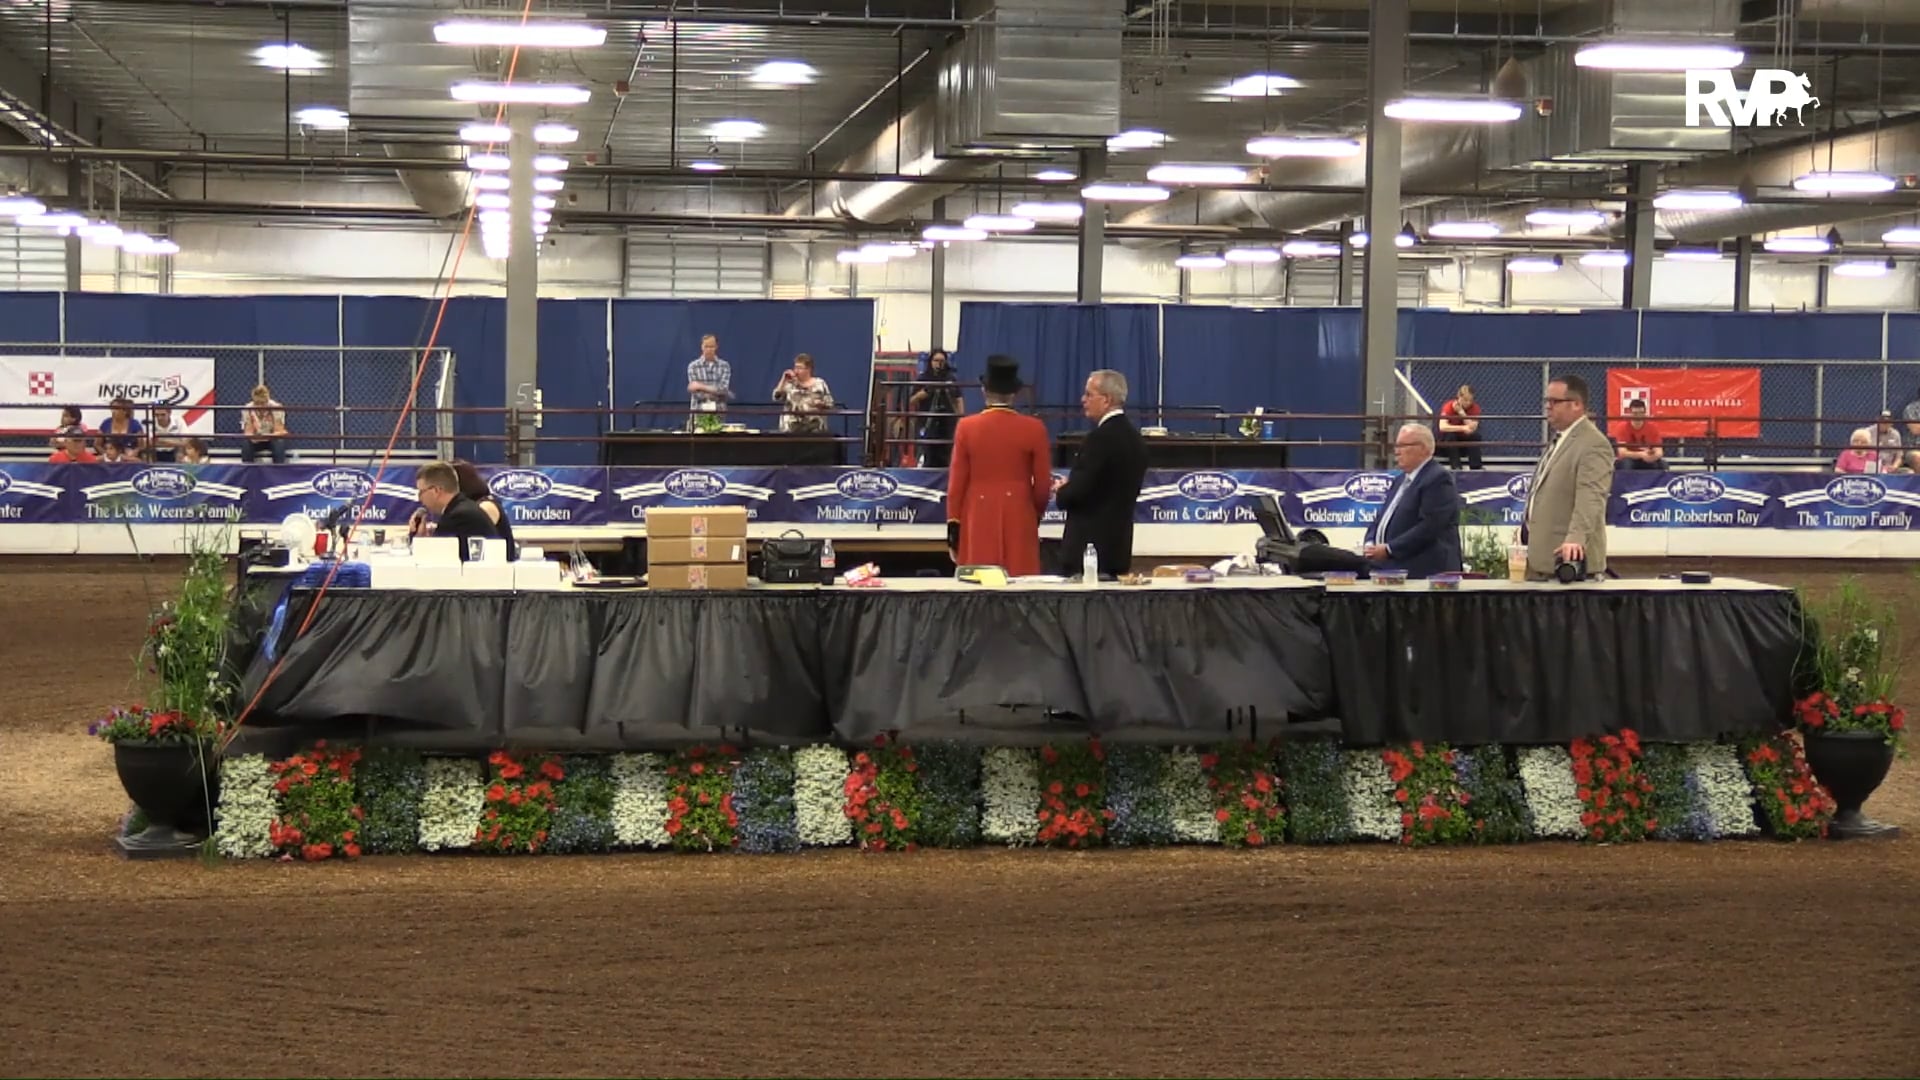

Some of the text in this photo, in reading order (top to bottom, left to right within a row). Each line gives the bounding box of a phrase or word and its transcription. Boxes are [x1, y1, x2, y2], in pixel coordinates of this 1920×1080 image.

[98, 384, 161, 399] INSIGHT
[84, 503, 110, 518] The
[511, 504, 571, 520] Thordsen
[816, 505, 917, 523] Mulberry Family
[1150, 505, 1178, 520] Tom
[1182, 506, 1190, 520] &
[1194, 506, 1231, 525] Cindy
[1737, 509, 1760, 527] Ray
[1797, 510, 1912, 531] The Tampa Family
